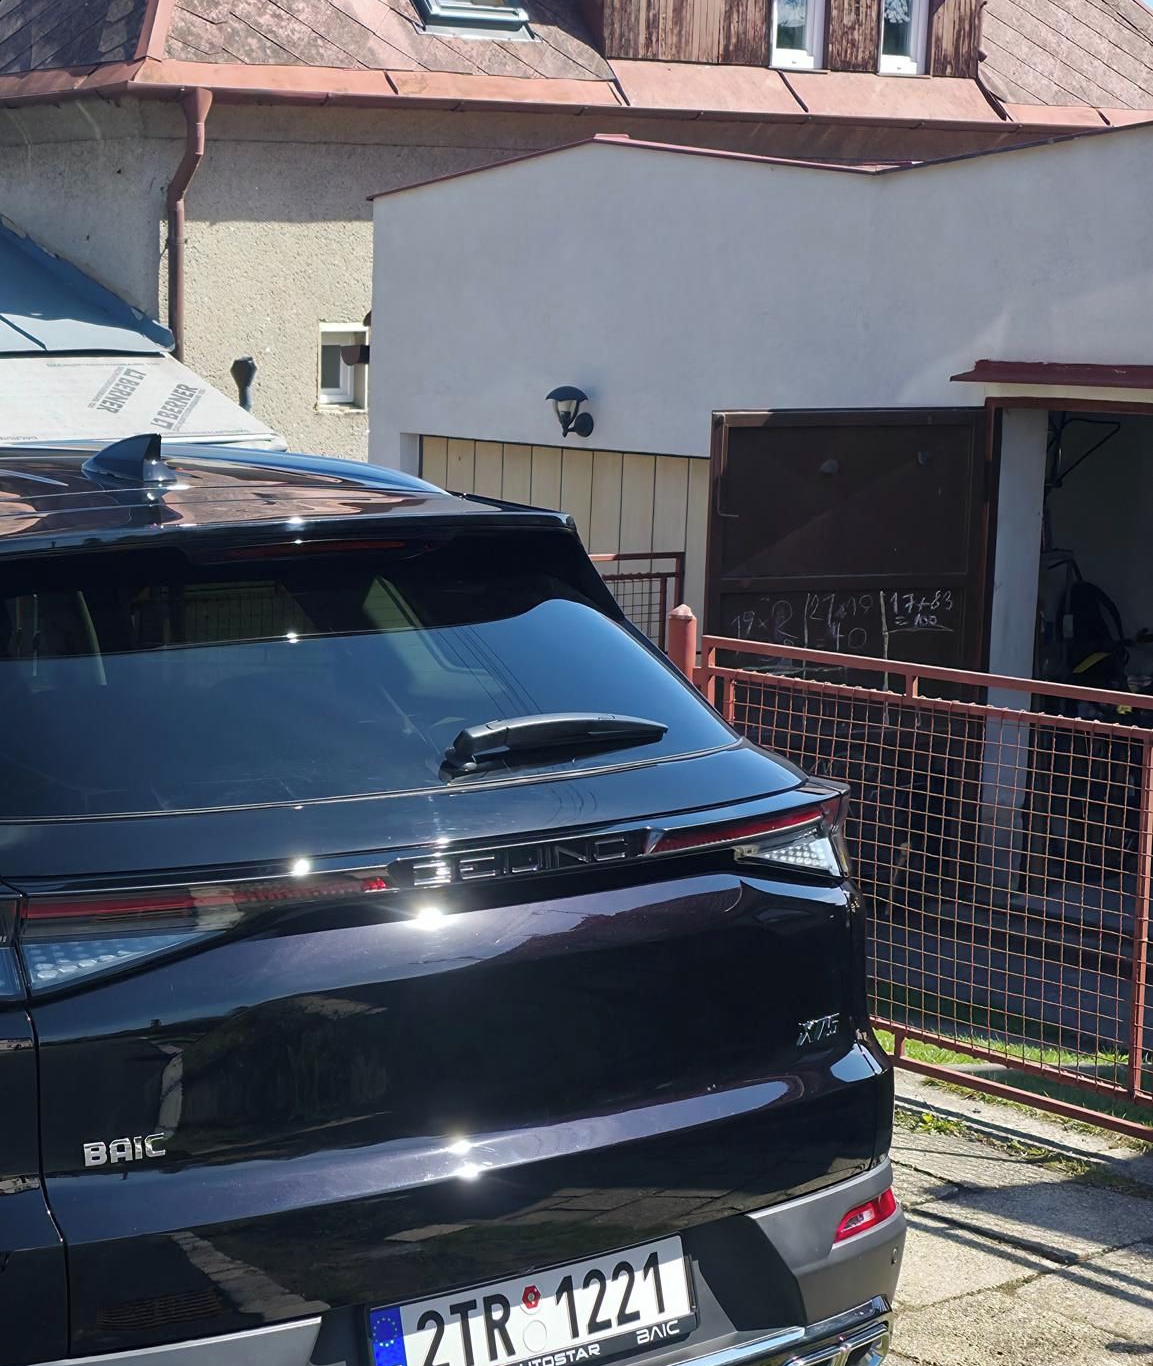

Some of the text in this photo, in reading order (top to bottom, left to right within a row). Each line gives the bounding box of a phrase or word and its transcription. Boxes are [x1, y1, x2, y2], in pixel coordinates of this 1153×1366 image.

[96, 377, 140, 414] BERNER
[156, 382, 199, 421] BERNER
[83, 1132, 166, 1167] BAIC
[555, 1252, 665, 1339] 1221
[636, 1319, 680, 1345] BAIC
